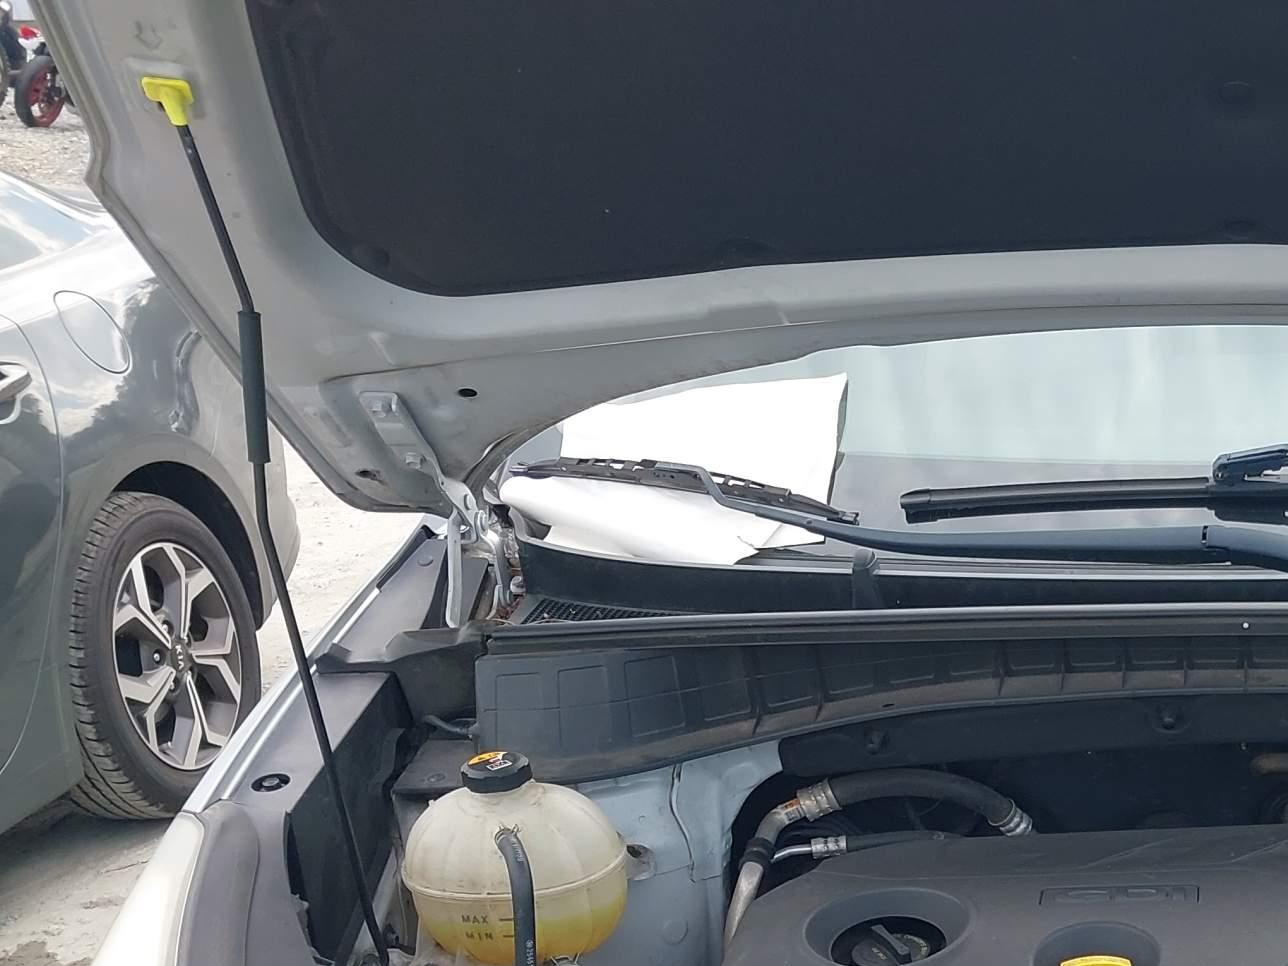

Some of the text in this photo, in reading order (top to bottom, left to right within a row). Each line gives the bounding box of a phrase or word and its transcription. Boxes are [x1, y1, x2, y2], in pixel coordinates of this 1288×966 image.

[175, 644, 184, 670] KIA
[461, 914, 489, 924] MAX
[465, 931, 494, 941] MIN
